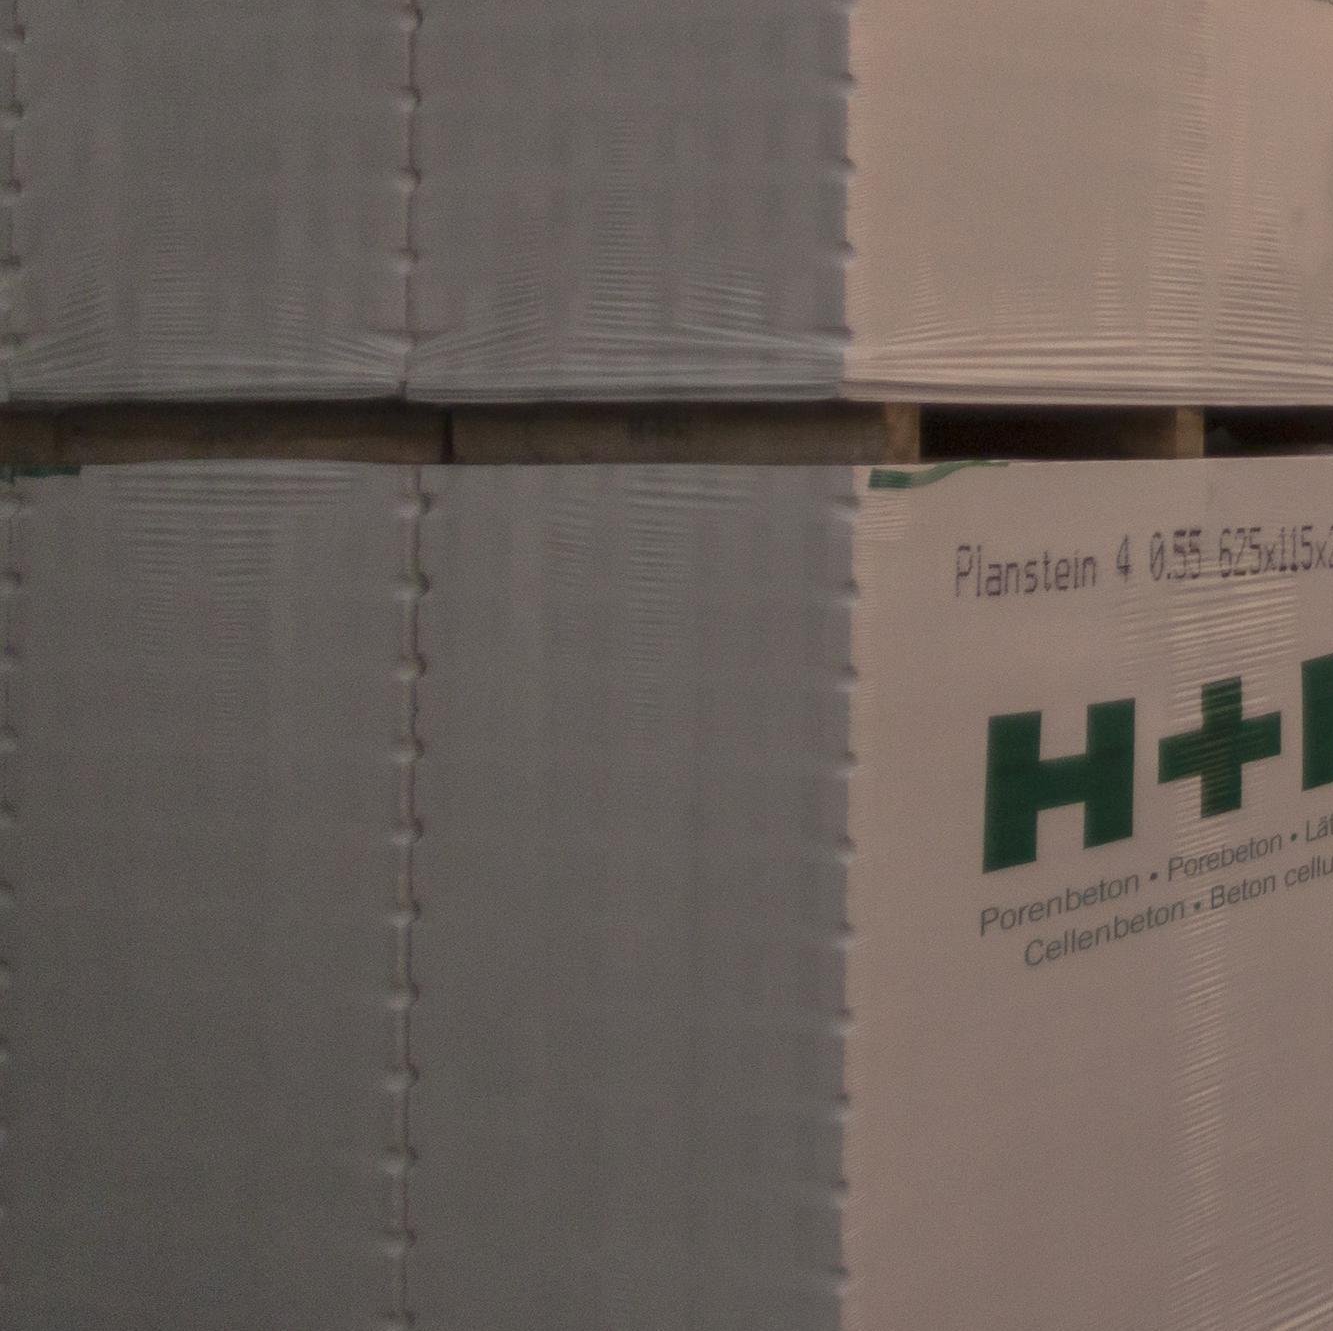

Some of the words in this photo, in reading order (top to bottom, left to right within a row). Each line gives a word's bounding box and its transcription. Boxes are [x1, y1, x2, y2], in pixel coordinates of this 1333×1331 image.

[955, 543, 1097, 598] Planstein
[1116, 533, 1131, 582] 4
[1150, 530, 1202, 581] 0.55
[979, 872, 1140, 937] Porenbeton
[1167, 831, 1283, 882] Porebeton
[1024, 899, 1185, 967] Cellenbeton
[1211, 872, 1276, 911] Beton
